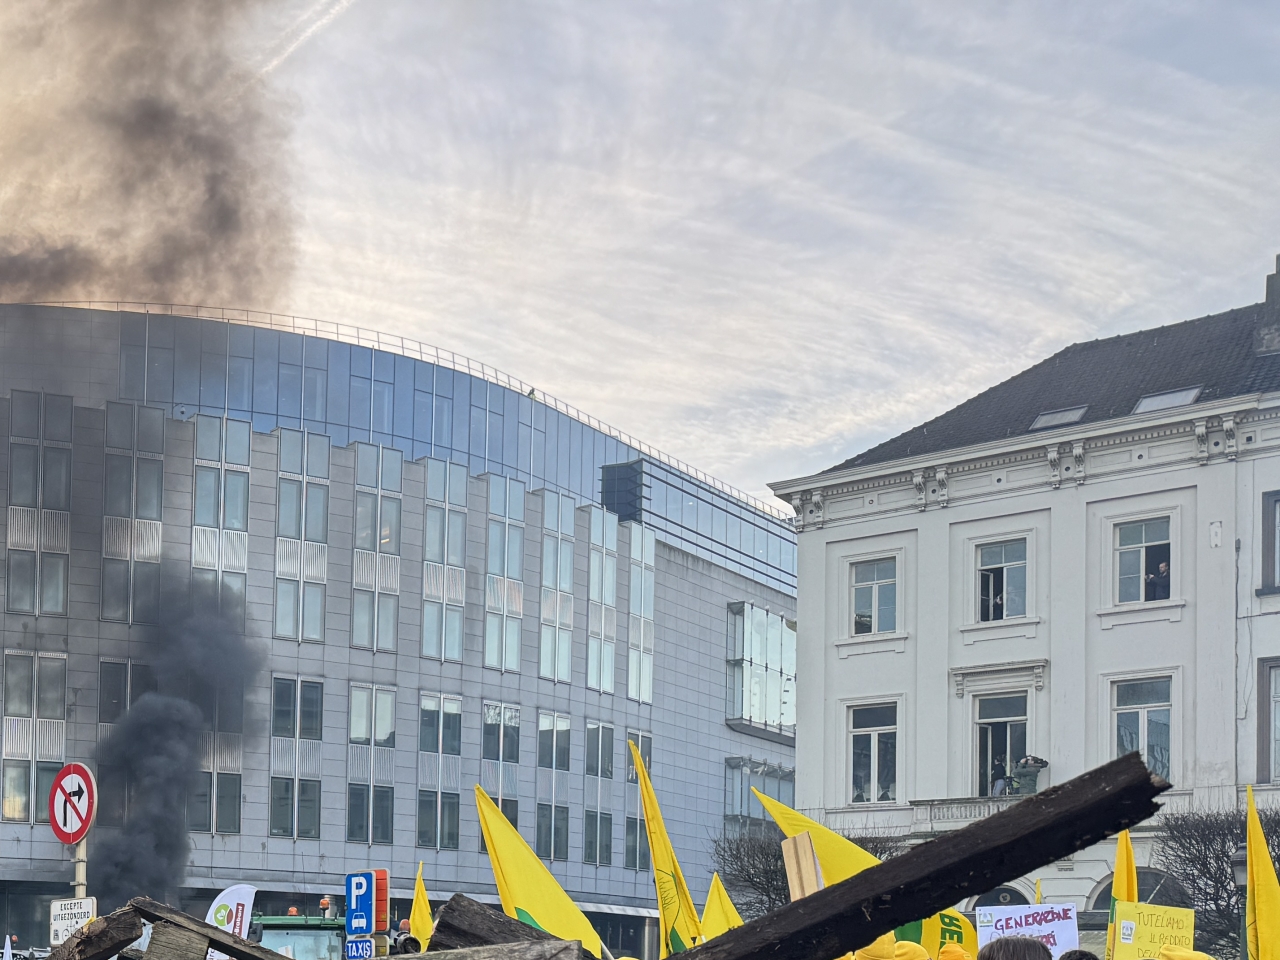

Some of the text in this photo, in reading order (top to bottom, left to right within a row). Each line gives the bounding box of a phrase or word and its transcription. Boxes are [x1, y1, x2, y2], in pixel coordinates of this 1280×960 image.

[351, 876, 368, 910] P
[52, 911, 90, 922] UITGEZONDERD
[1149, 932, 1190, 946] IL REDDITO
[348, 943, 372, 958] TAXIS
